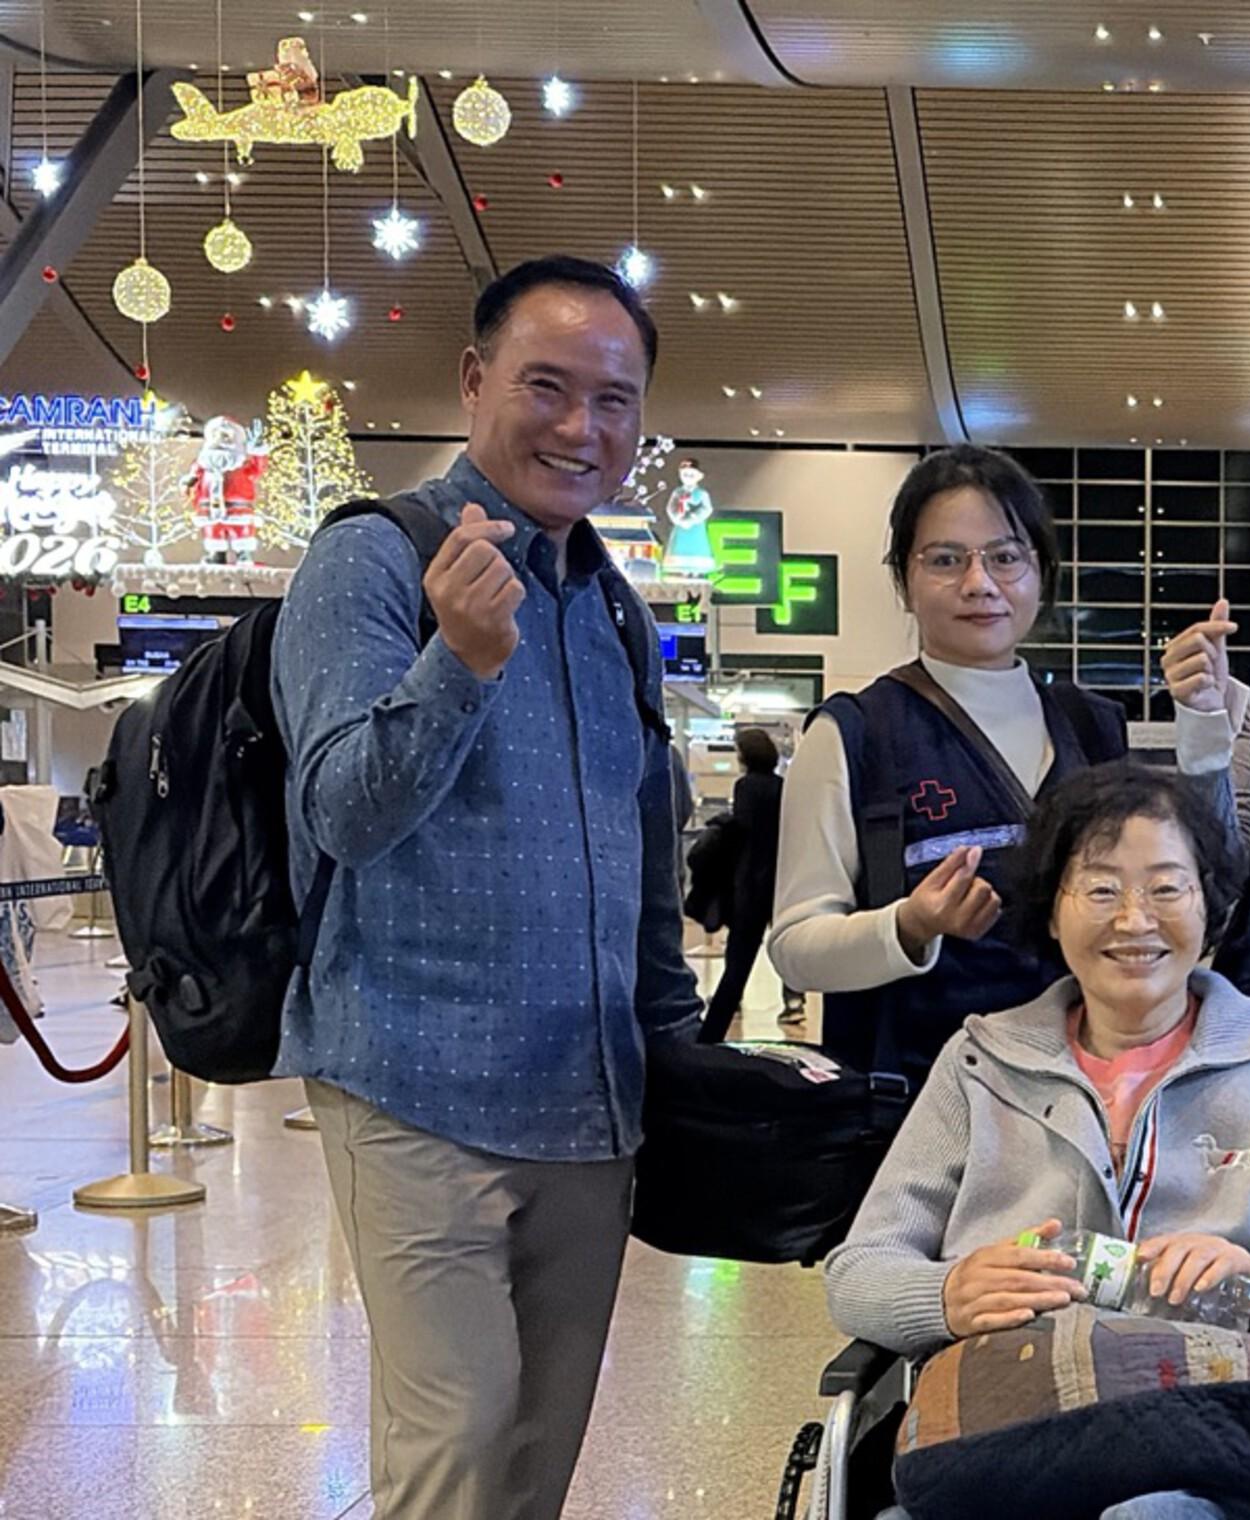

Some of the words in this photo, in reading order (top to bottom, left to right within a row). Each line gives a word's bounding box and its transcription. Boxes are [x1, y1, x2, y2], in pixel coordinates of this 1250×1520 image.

[0, 533, 120, 576] 026
[707, 522, 761, 594] E
[124, 595, 151, 613] E4
[677, 604, 702, 622] E1
[775, 562, 820, 624] F
